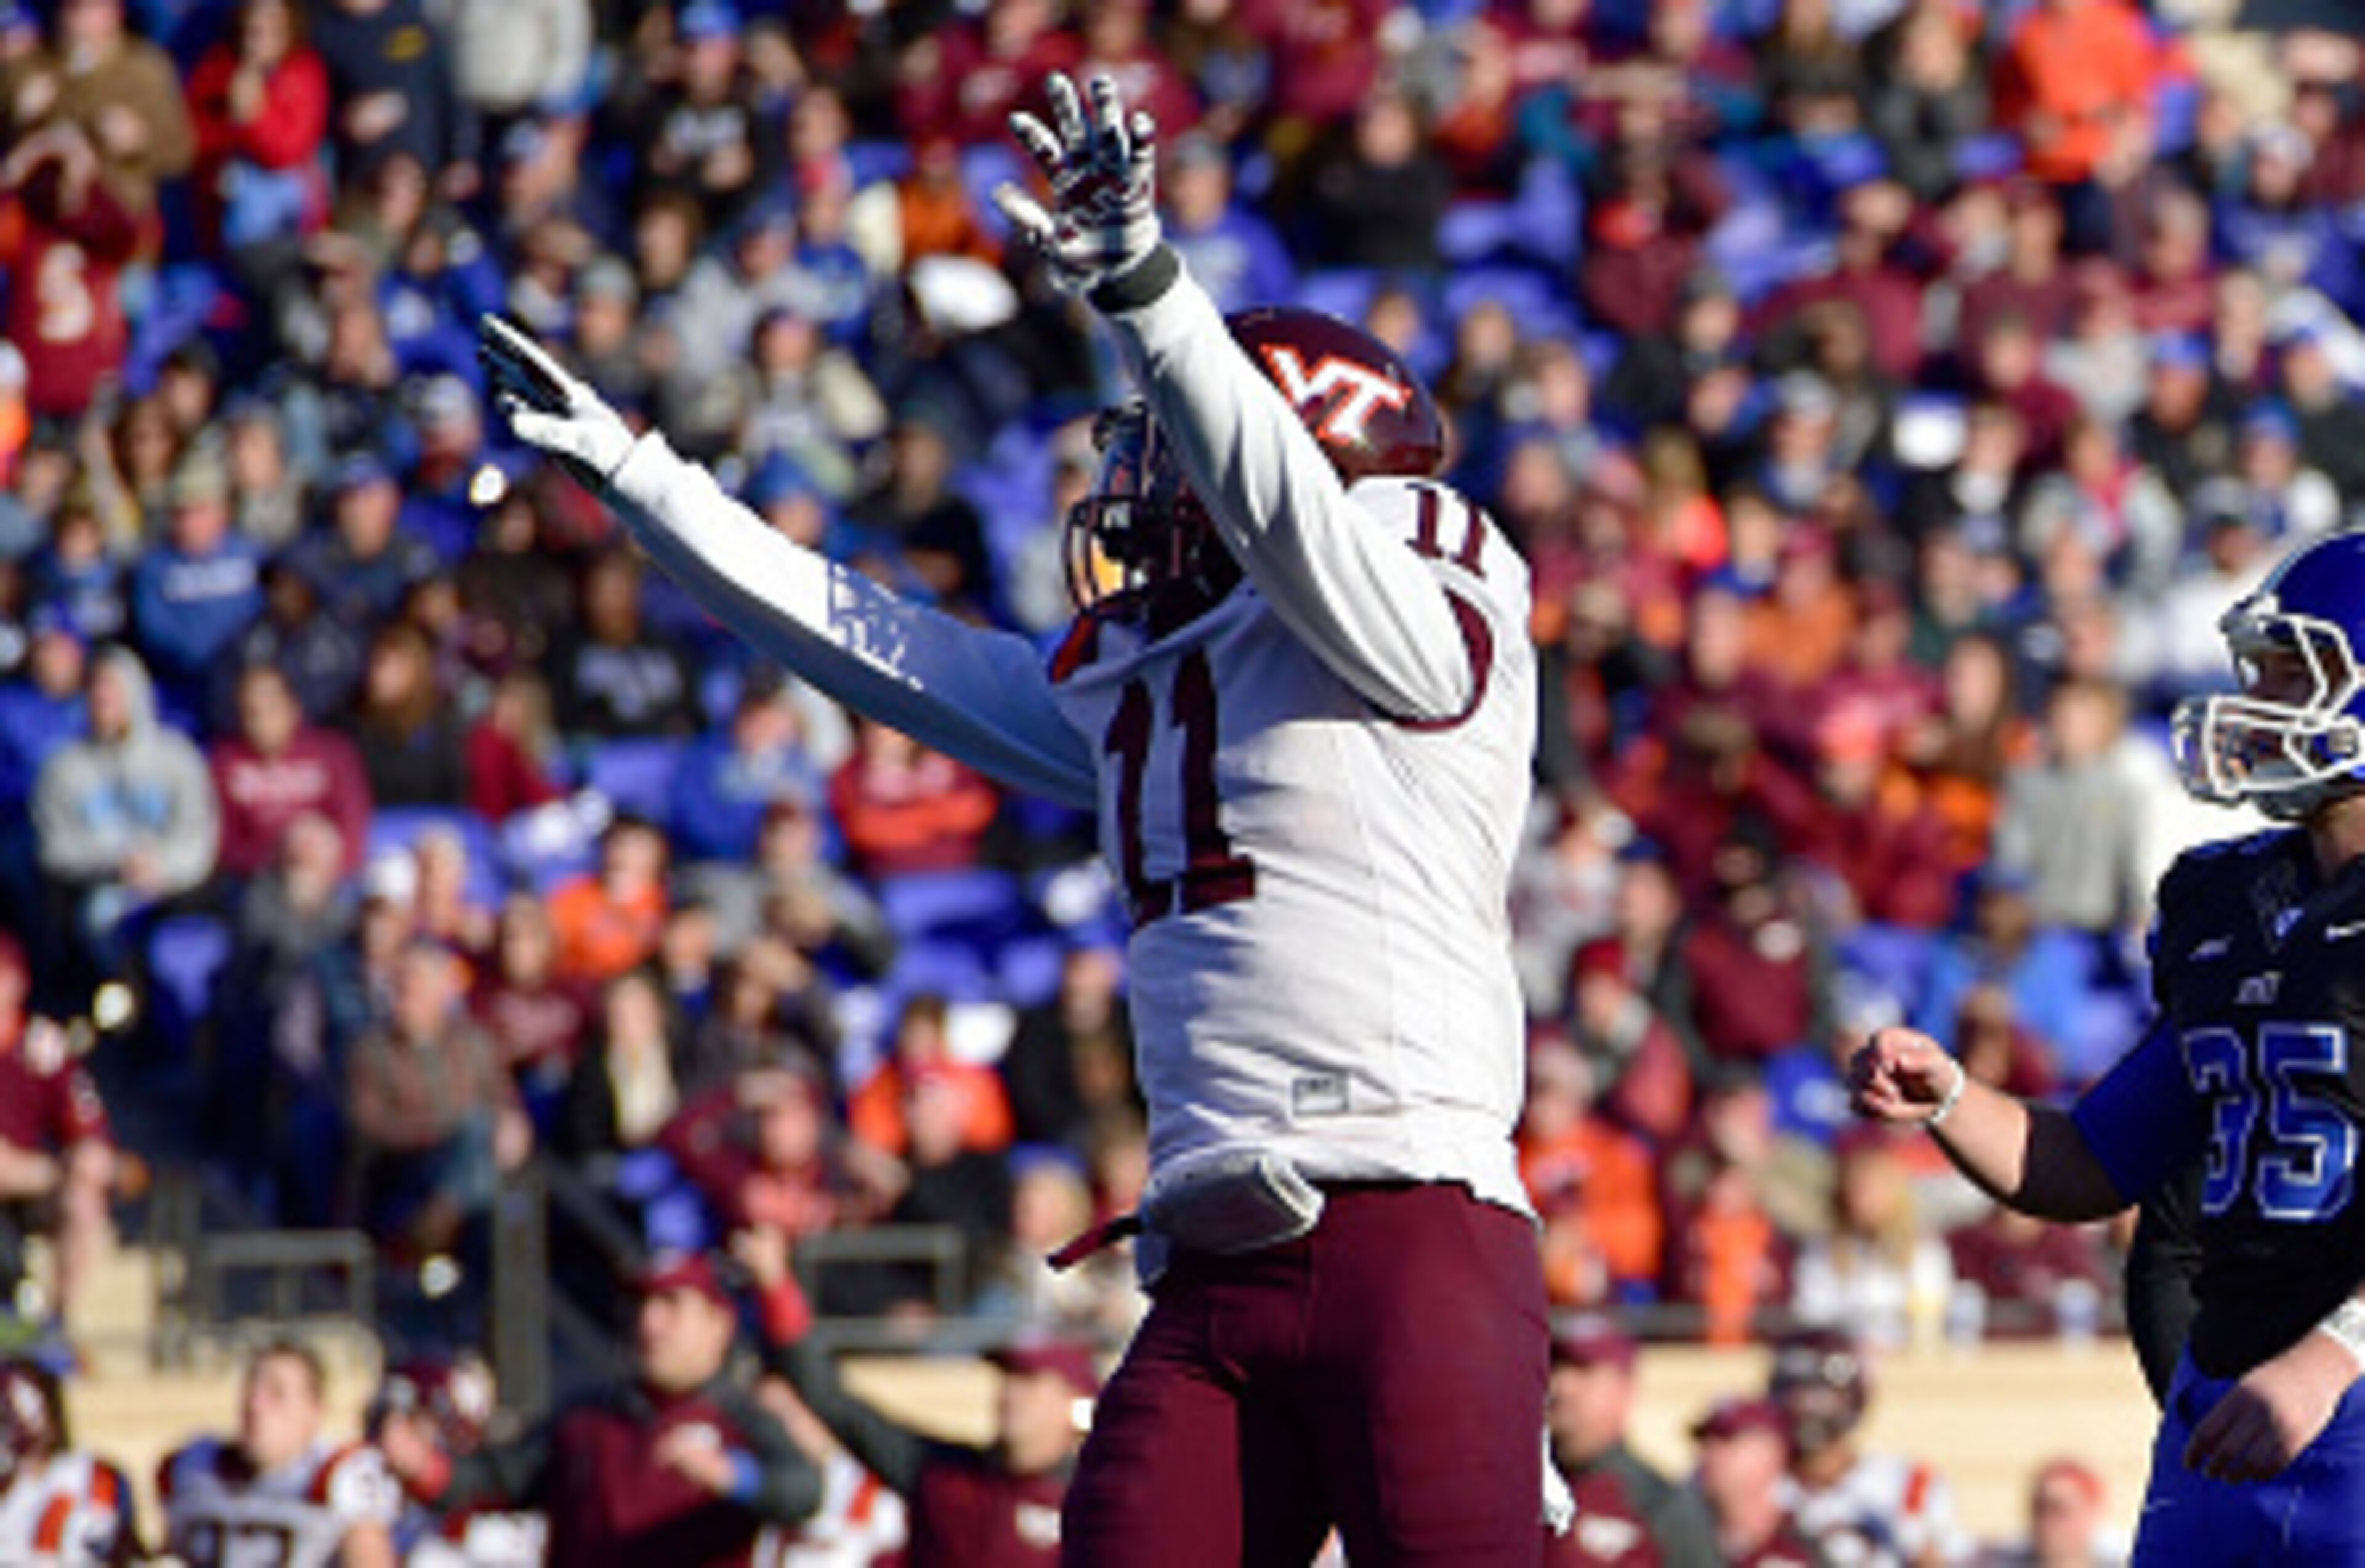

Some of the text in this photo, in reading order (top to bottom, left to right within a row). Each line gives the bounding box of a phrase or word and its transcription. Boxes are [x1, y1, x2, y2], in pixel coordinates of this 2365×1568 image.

[1259, 343, 1413, 447] VT
[1405, 482, 1486, 581] 11
[1105, 642, 1256, 929] 11
[2182, 1020, 2360, 1221] 35
